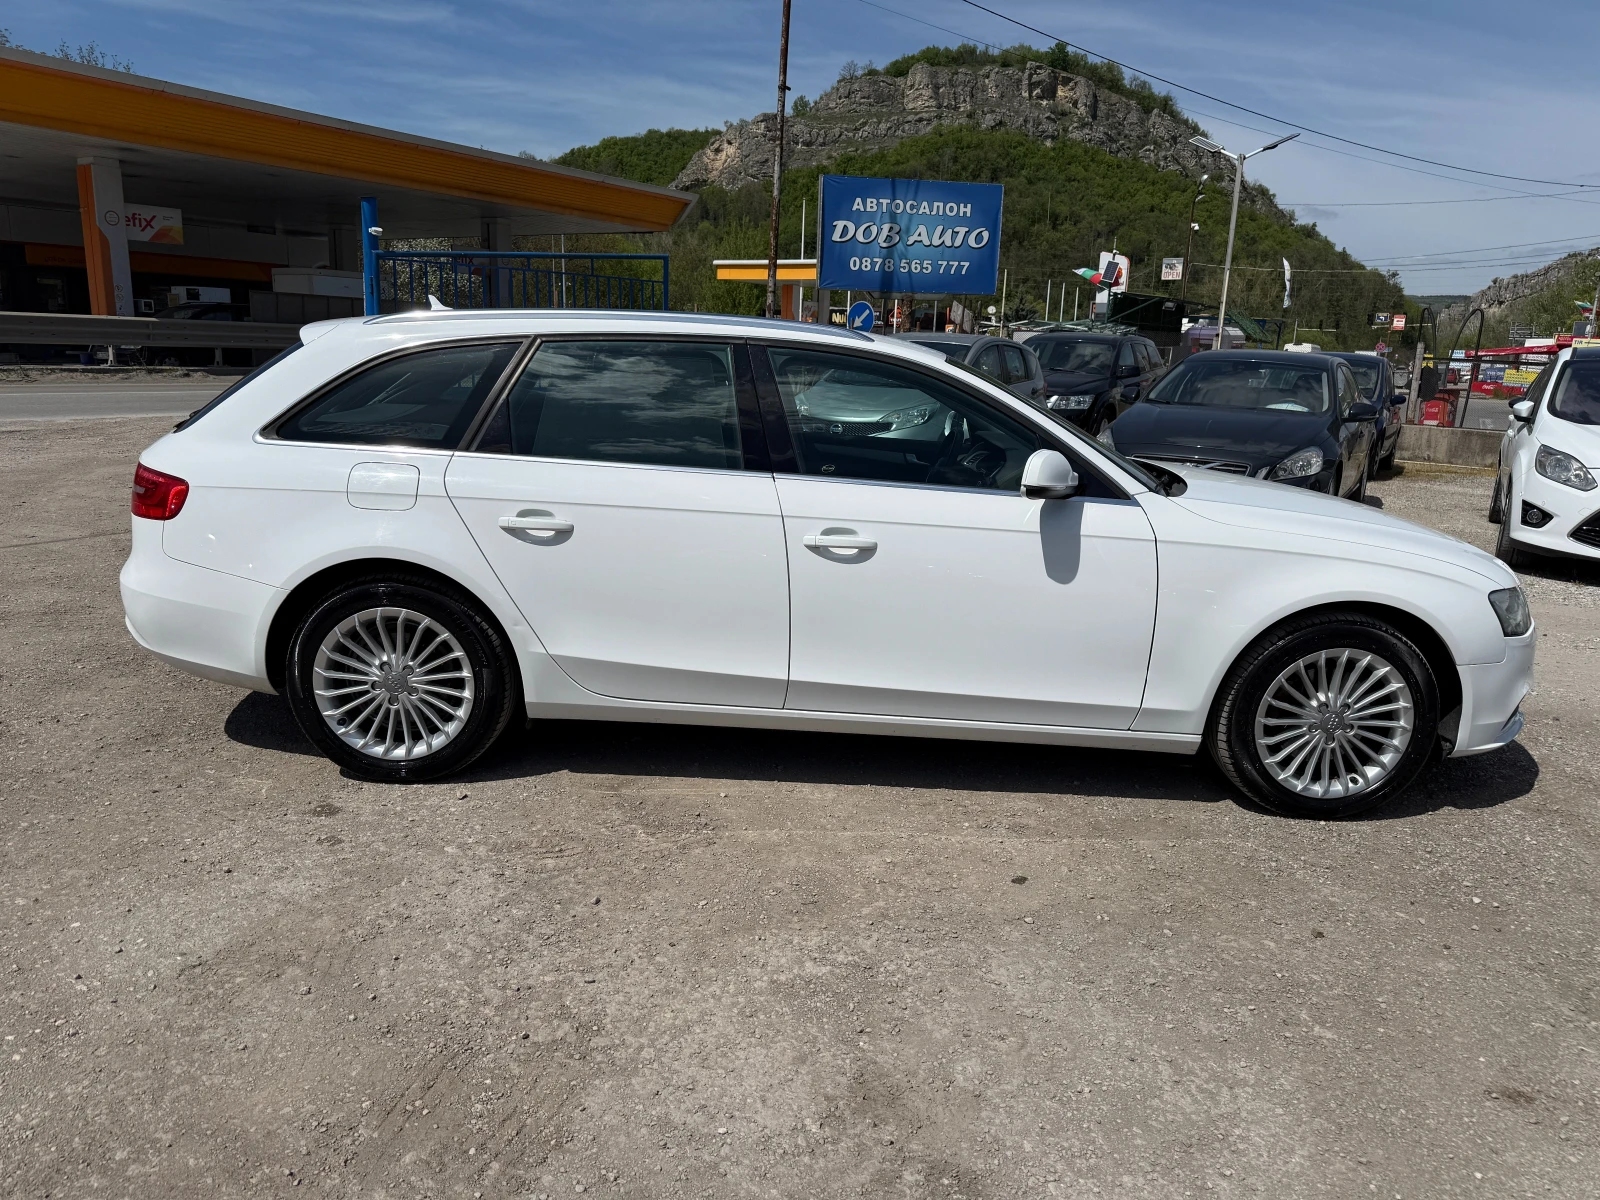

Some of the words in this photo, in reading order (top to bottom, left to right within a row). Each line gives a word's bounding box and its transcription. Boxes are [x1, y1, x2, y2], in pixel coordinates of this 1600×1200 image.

[851, 197, 972, 217] АВТОСАЛОН
[831, 220, 901, 249] DOB
[906, 224, 990, 249] AUTO
[849, 256, 894, 272] 0878
[899, 259, 932, 274] 565
[937, 260, 971, 275] 777
